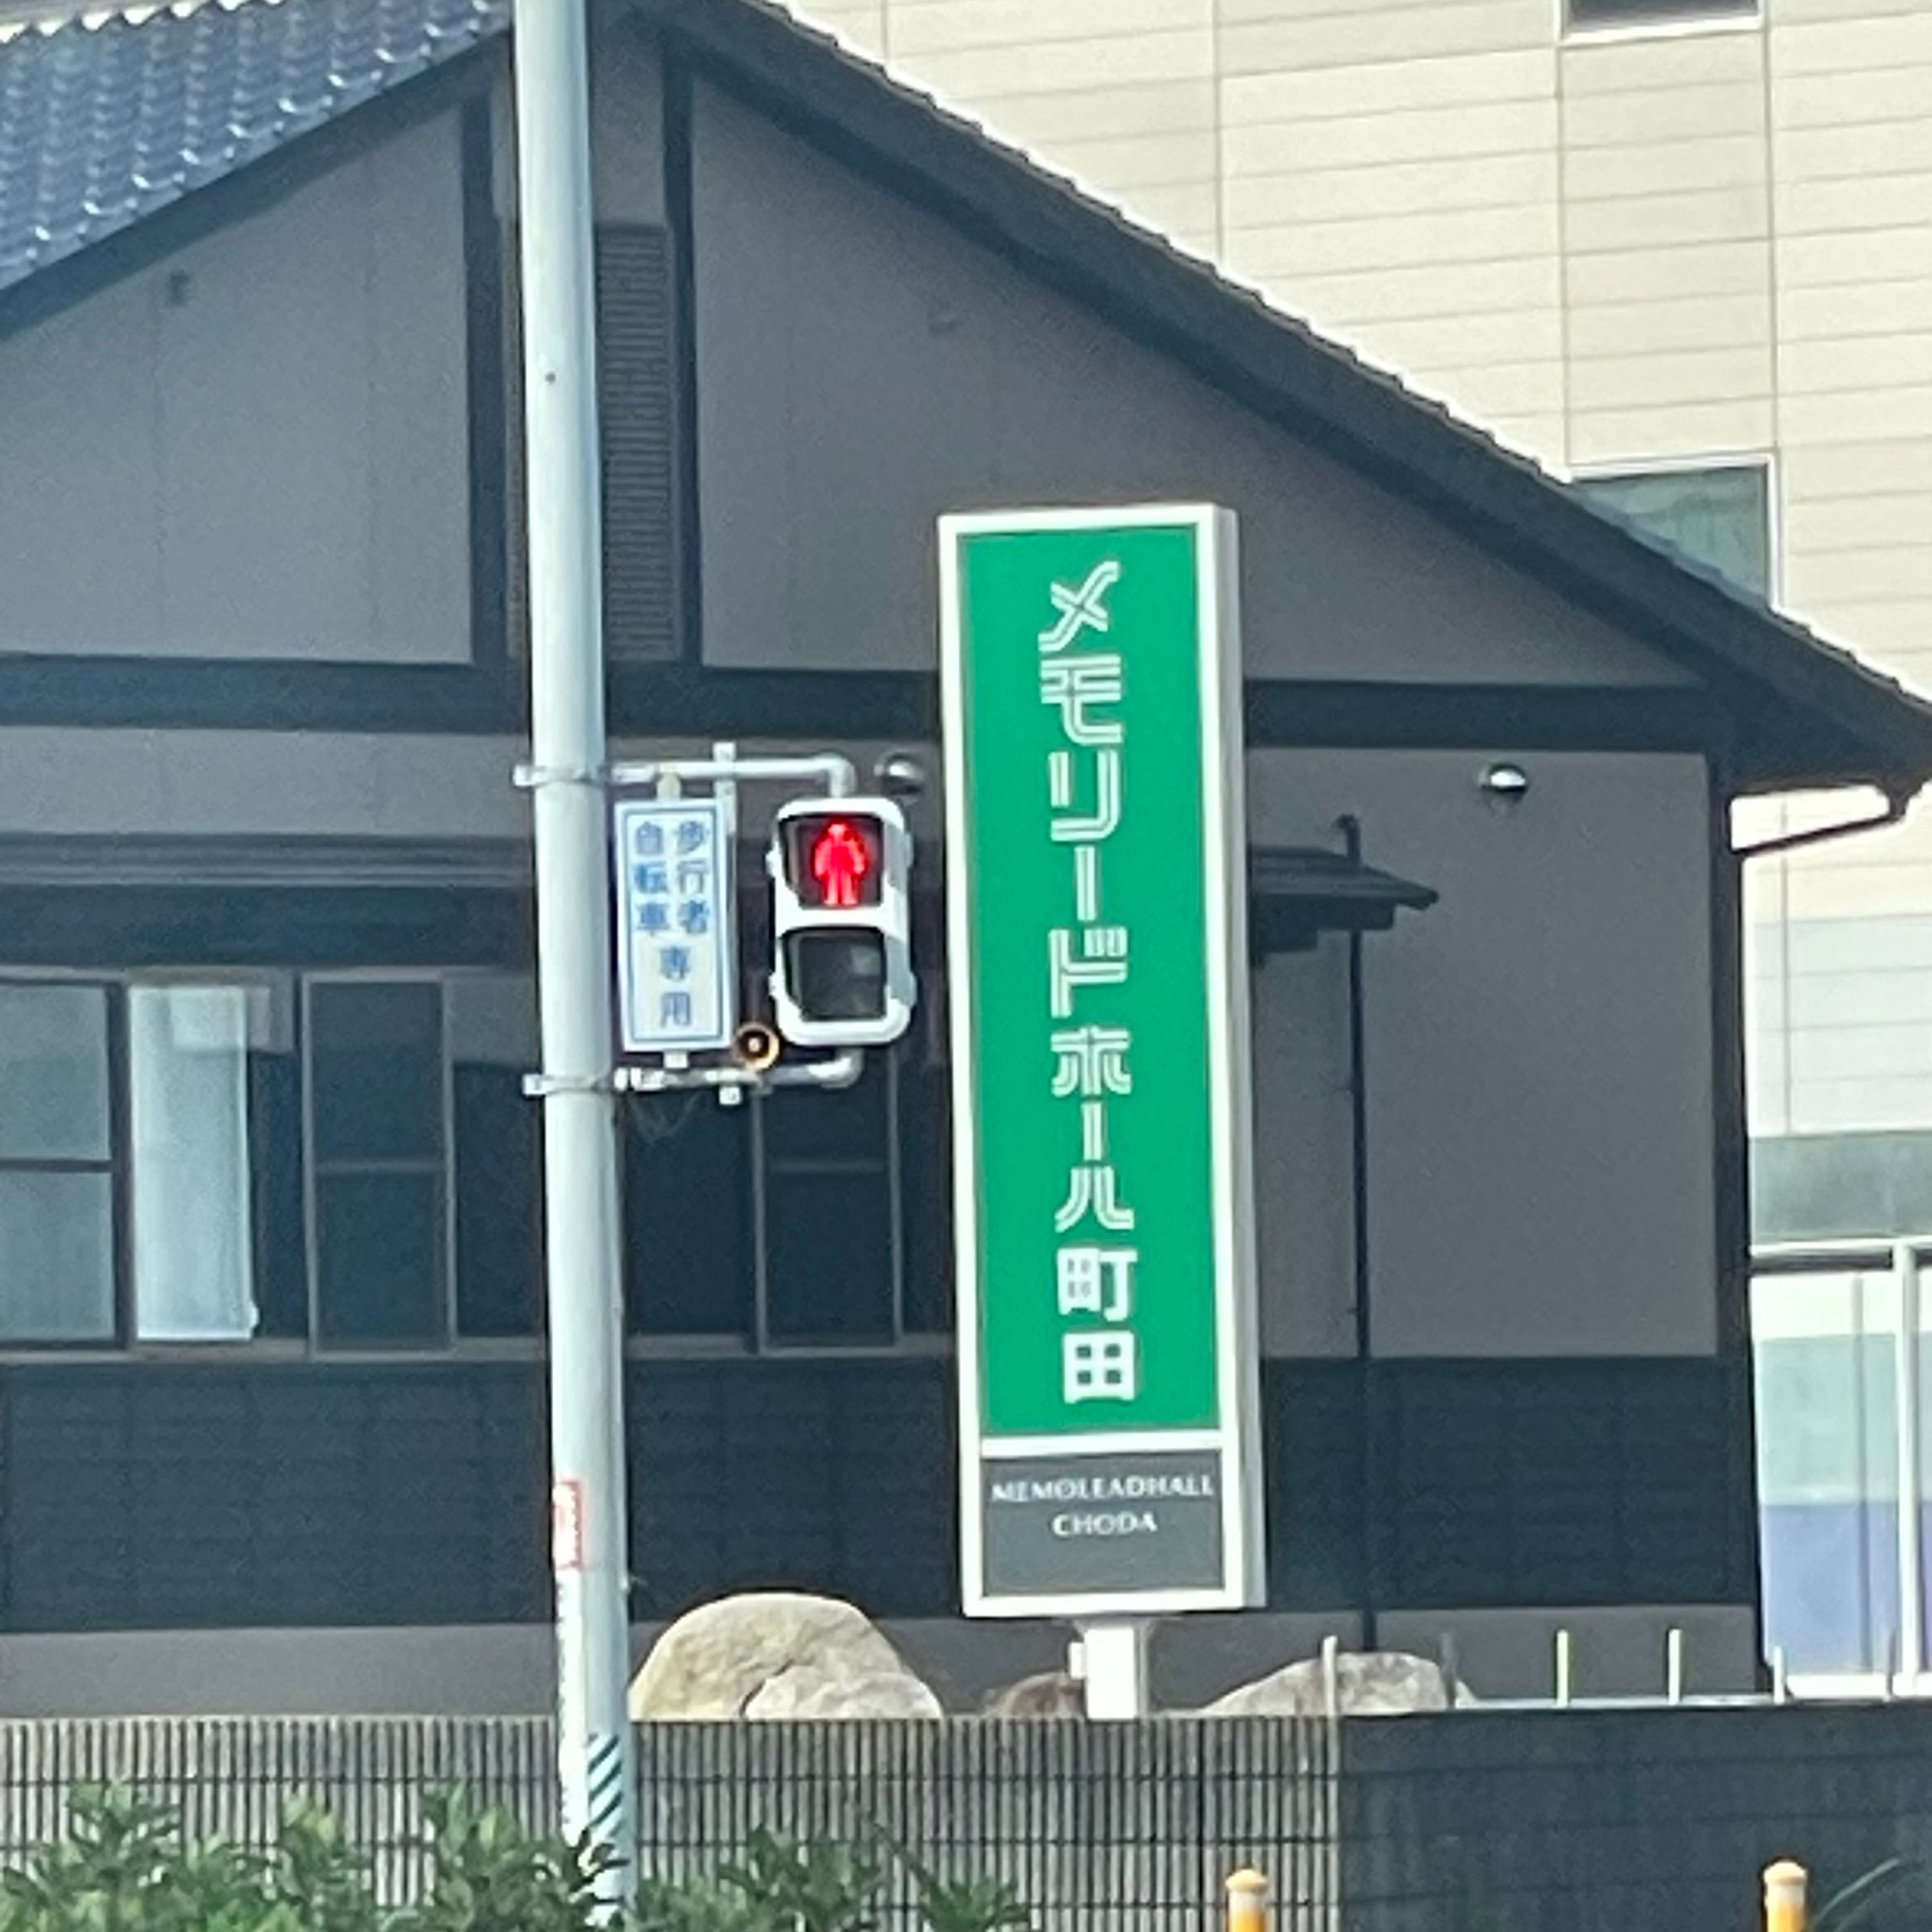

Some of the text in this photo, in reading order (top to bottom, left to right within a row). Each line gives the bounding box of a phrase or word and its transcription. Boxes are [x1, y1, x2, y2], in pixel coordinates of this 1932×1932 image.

[1038, 560, 1138, 1404] メモリードホール町田
[992, 1475, 1214, 1502] MEMOLEADHALL
[1051, 1510, 1158, 1536] CHODA
